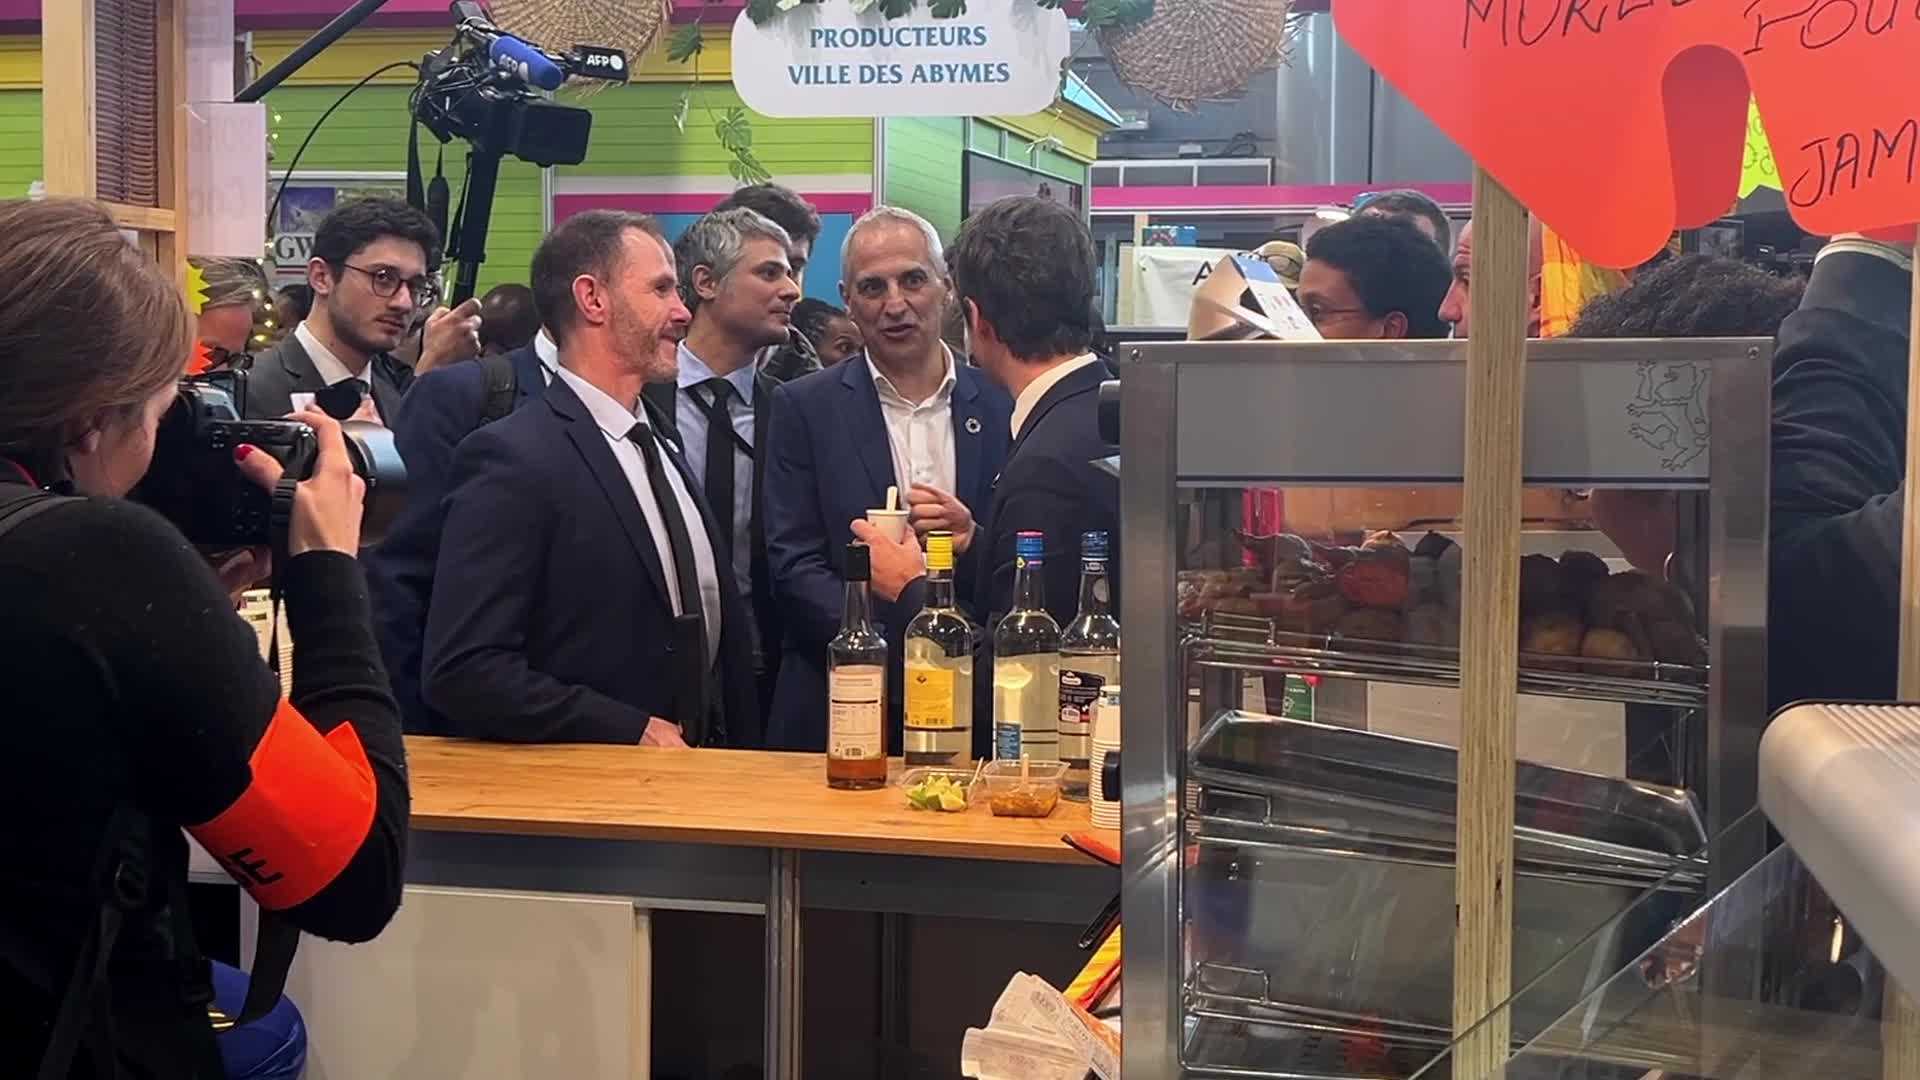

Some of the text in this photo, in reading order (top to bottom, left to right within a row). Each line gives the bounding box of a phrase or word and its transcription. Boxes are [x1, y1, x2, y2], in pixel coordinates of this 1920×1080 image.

[810, 26, 987, 48] PRODUCTEURS
[586, 54, 609, 67] AFP
[787, 62, 1010, 85] VILLE DES ABYMES
